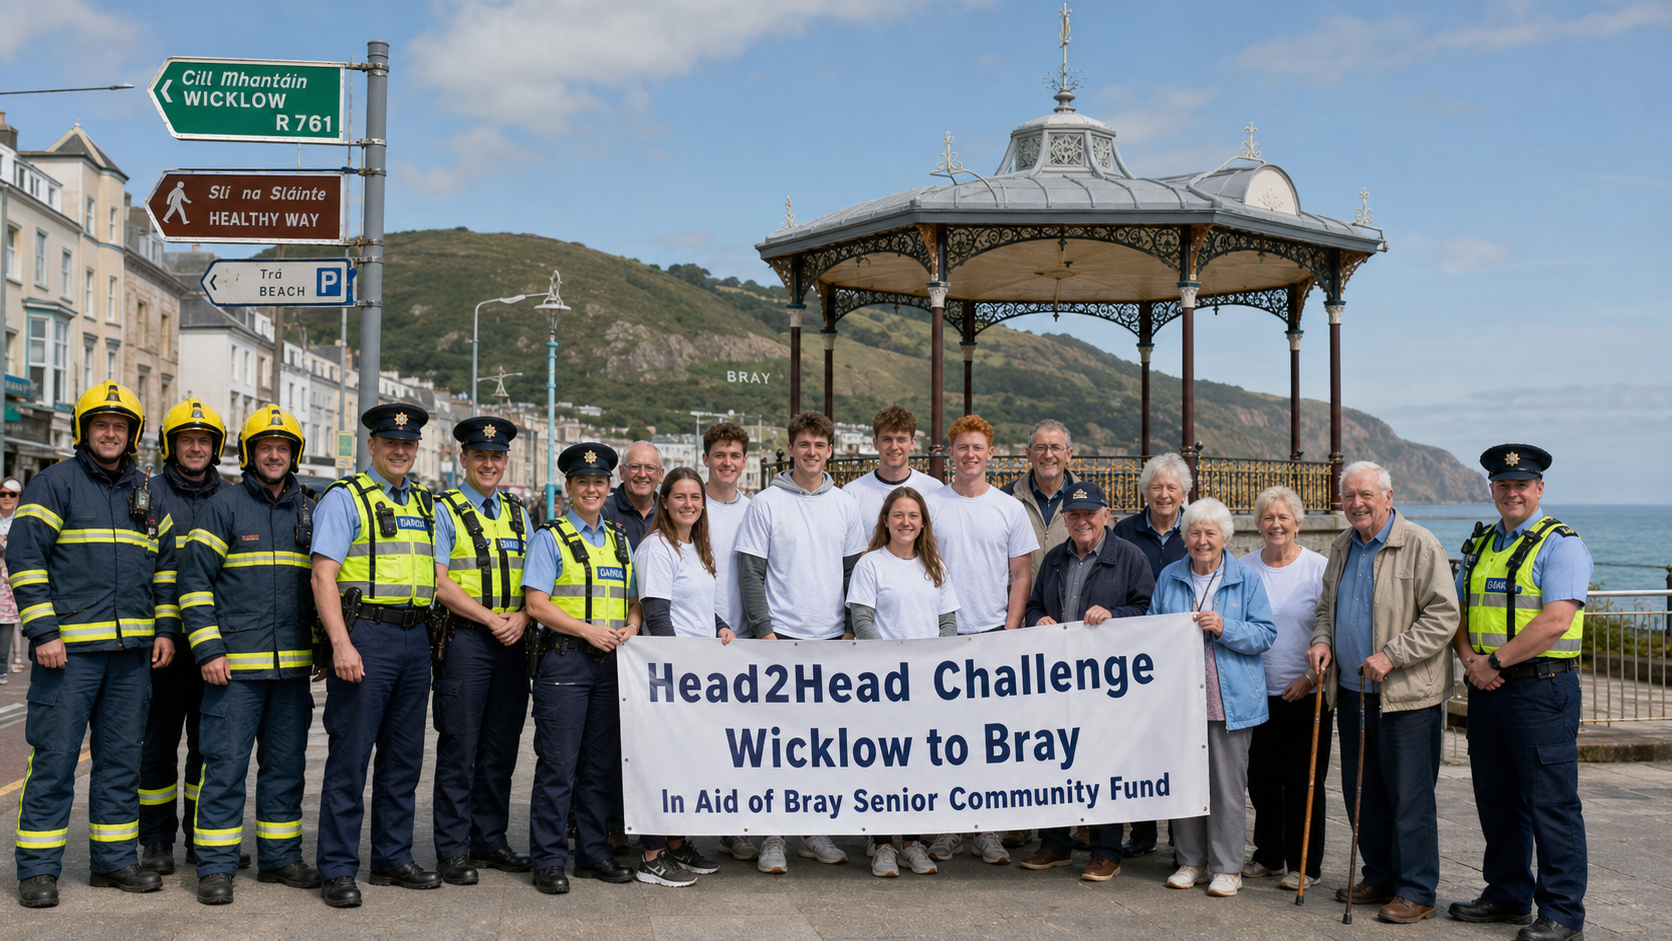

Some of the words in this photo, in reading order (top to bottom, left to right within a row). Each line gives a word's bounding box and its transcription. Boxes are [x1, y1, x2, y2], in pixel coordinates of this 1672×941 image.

[182, 70, 213, 86] Cill
[221, 71, 308, 89] Mhantáin
[184, 91, 287, 109] WICKLOW
[276, 114, 289, 131] R
[295, 115, 332, 133] 761
[208, 185, 231, 200] Slí
[242, 190, 261, 200] na
[270, 186, 327, 202] Sláinte
[209, 212, 279, 227] HEALTHY
[285, 213, 319, 228] WAY
[260, 268, 282, 280] Trá
[321, 271, 338, 293] P
[260, 287, 305, 297] BEACH
[726, 371, 771, 385] BRAY
[648, 662, 910, 704] Head2Head
[934, 653, 1155, 702] Challenge
[725, 727, 913, 768] Wicklow
[927, 729, 968, 766] to
[984, 722, 1081, 771] Bray
[662, 789, 685, 814] In
[695, 789, 739, 814] Aid
[748, 789, 774, 813] of
[785, 789, 843, 820] Bray
[854, 787, 939, 813] Senior
[950, 779, 1099, 811] Community
[1111, 772, 1170, 800] Fund
